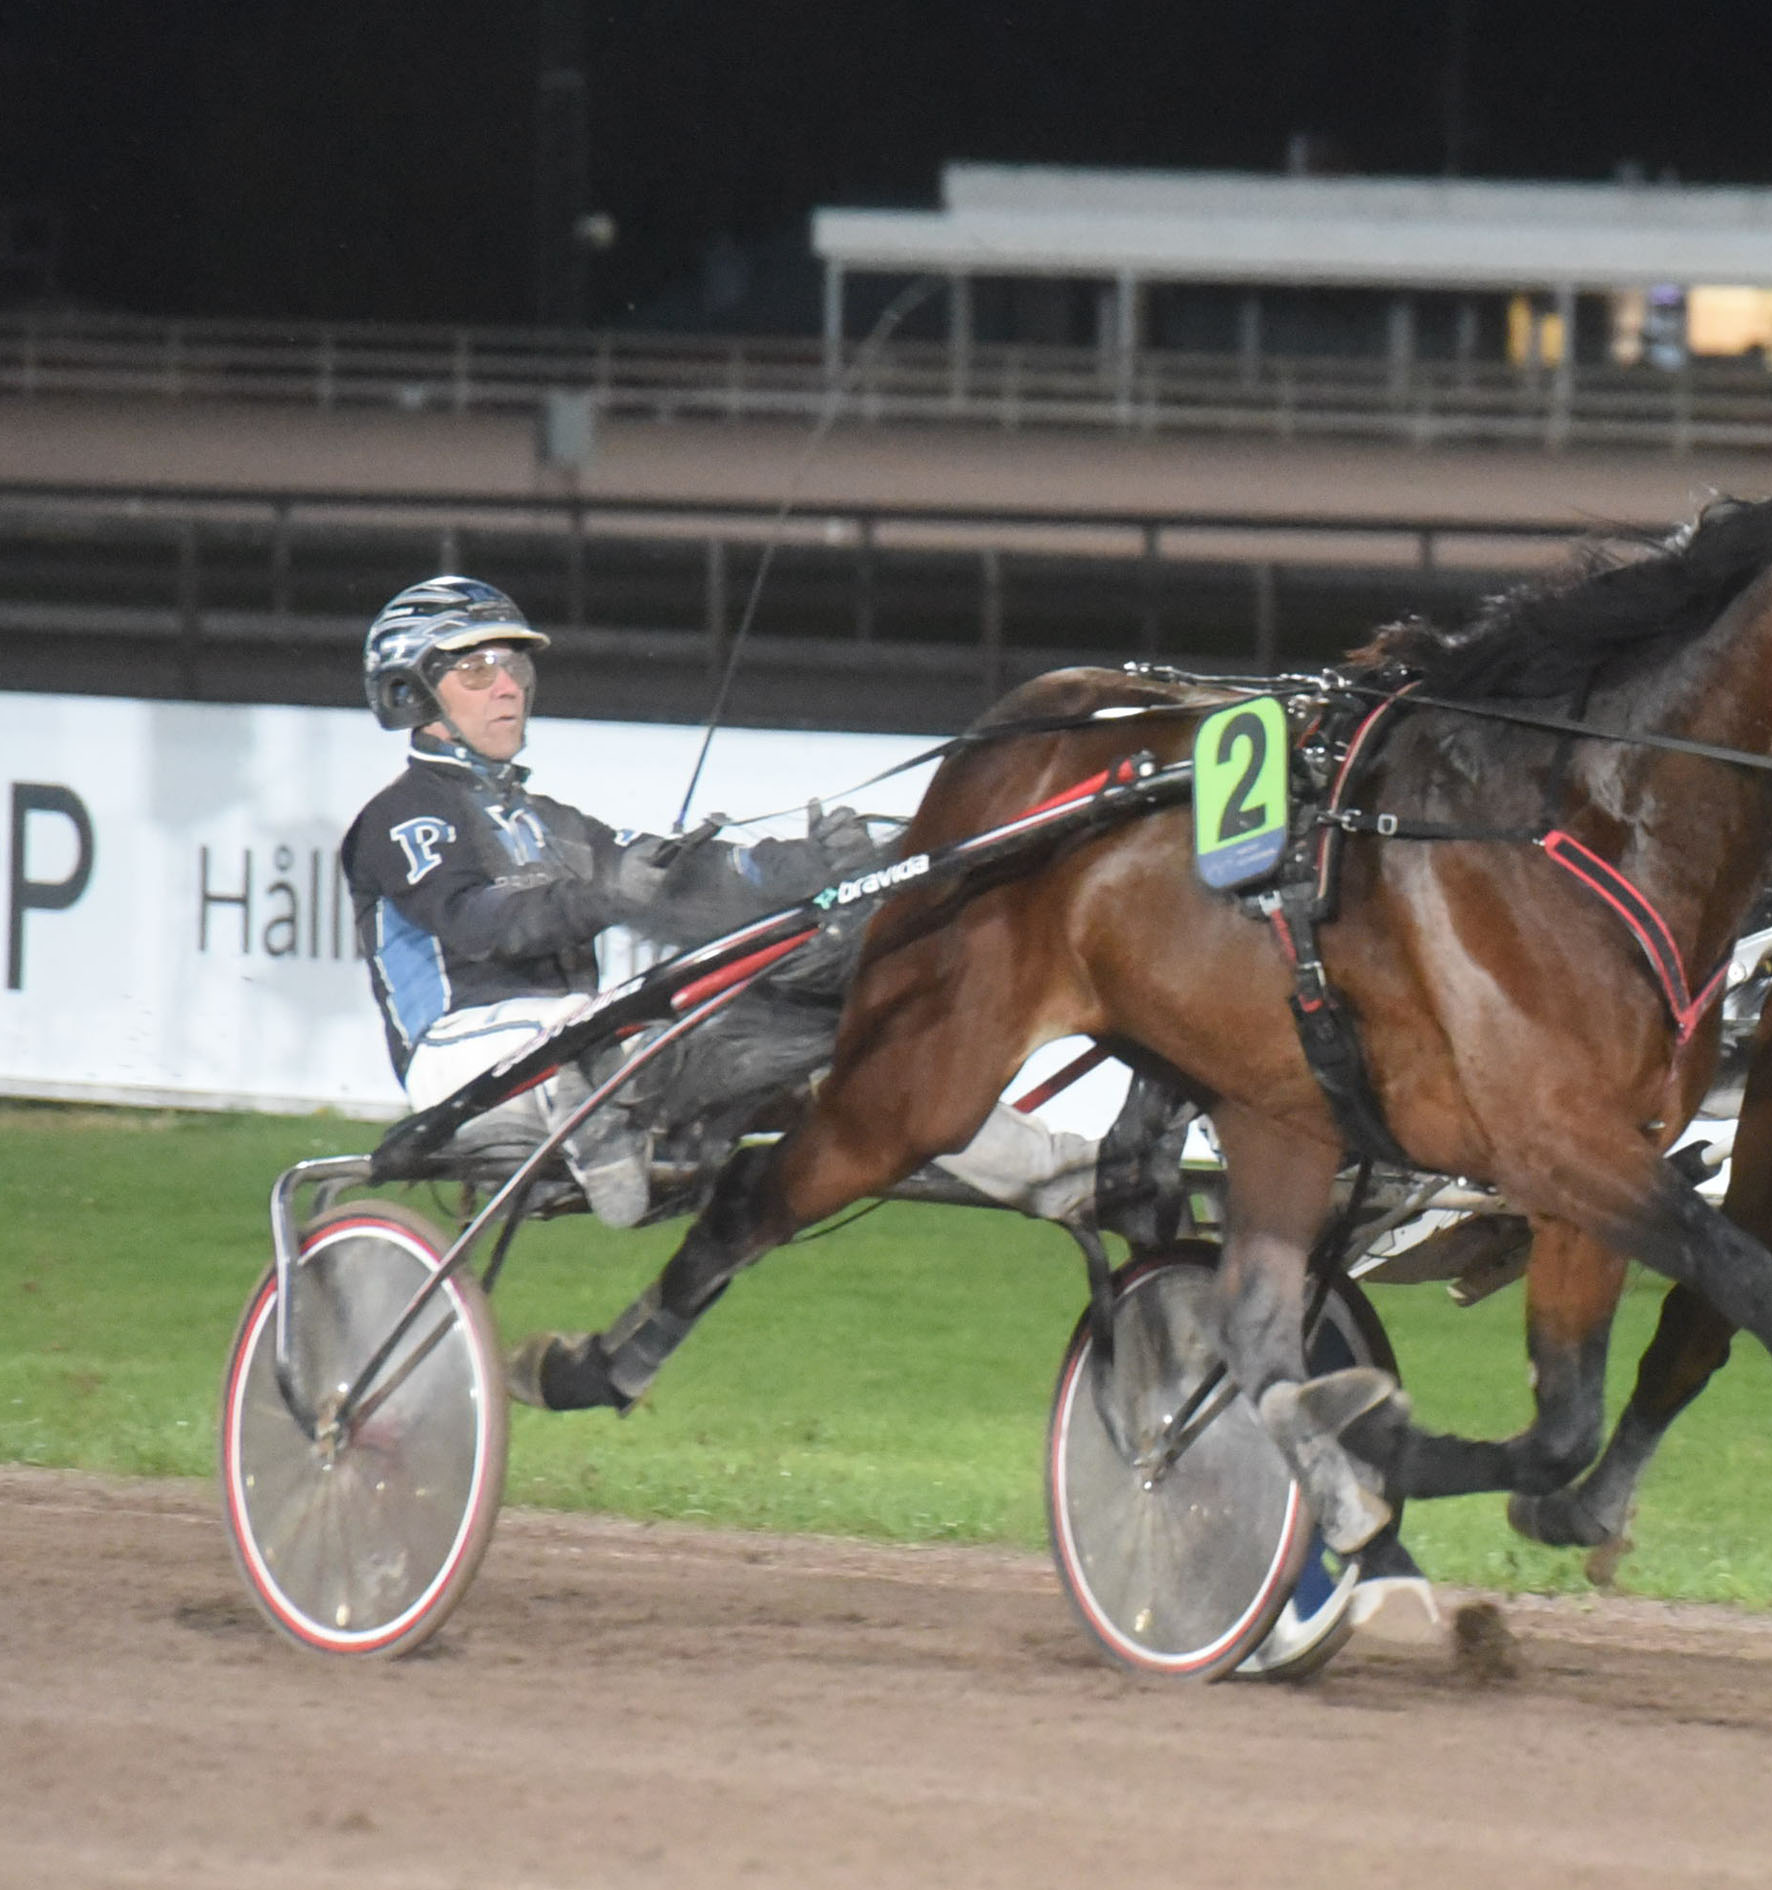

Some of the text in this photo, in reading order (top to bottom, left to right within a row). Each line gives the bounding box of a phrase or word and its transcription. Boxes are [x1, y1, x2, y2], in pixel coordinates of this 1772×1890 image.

[1216, 712, 1267, 843] 2
[7, 781, 95, 989] P
[197, 846, 366, 960] Håll
[390, 816, 457, 885] P
